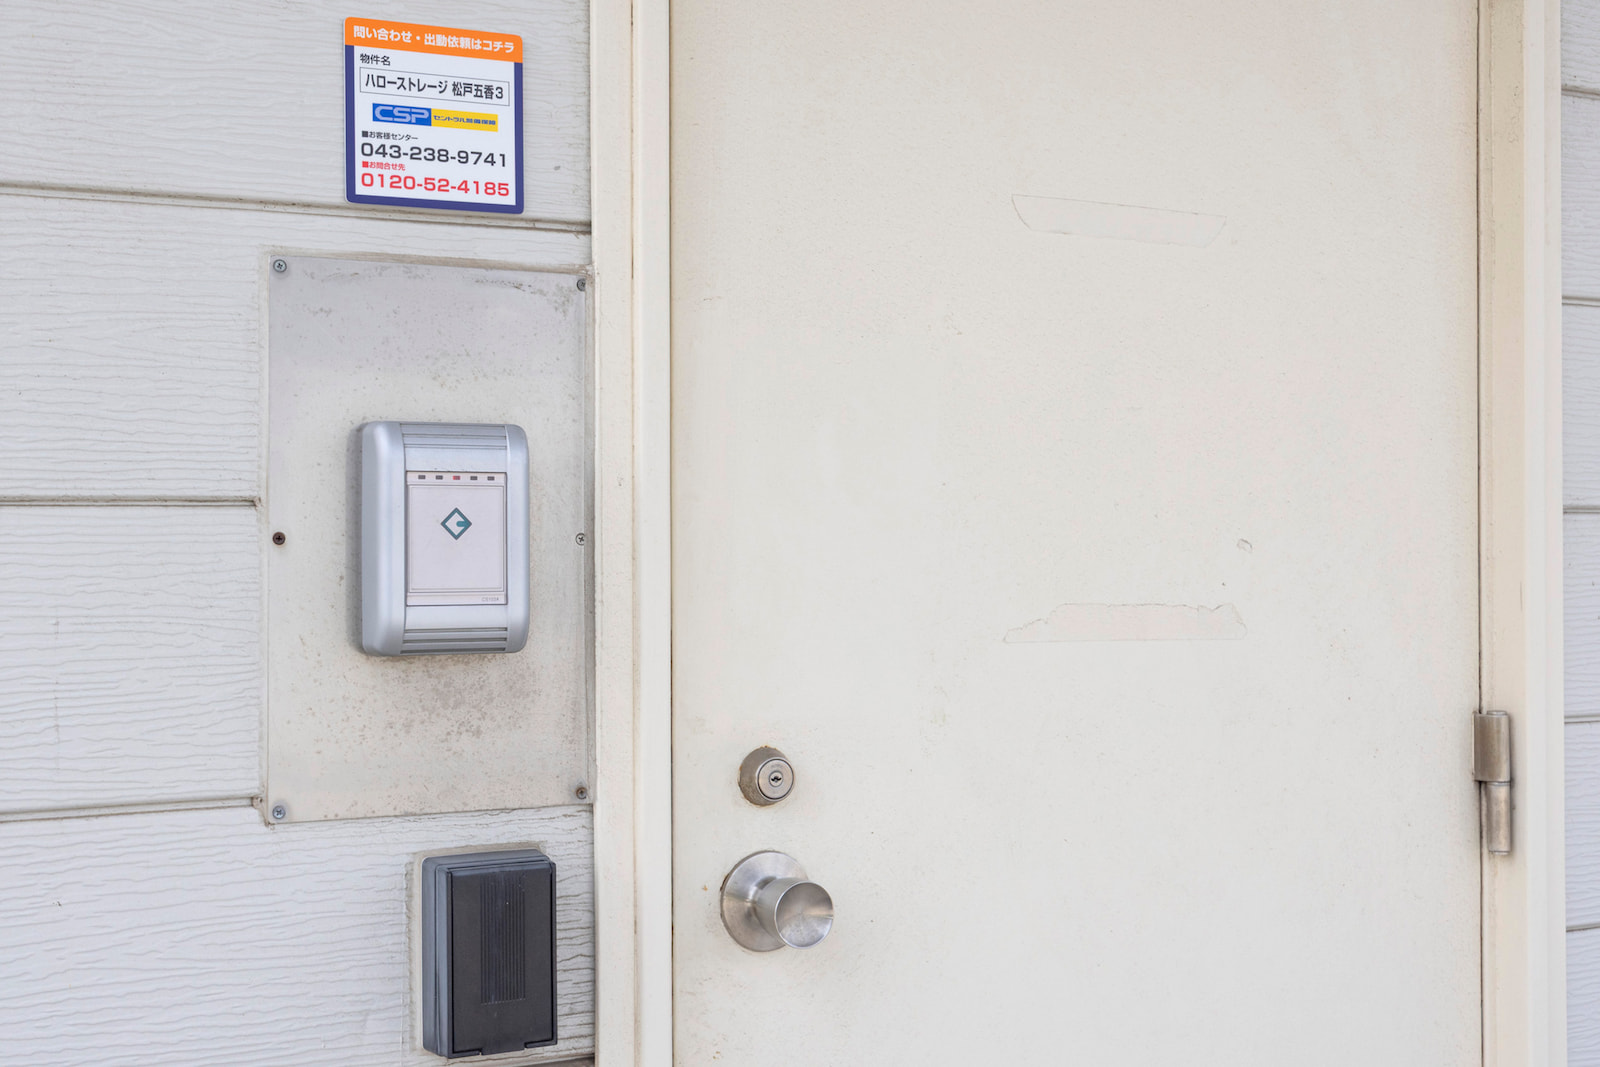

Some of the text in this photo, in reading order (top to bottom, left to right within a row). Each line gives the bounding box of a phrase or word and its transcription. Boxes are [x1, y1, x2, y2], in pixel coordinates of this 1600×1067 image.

[353, 25, 514, 53] 問い合わせ・出動依頼はコチラ
[360, 53, 391, 66] 物件名
[365, 73, 504, 100] ハローストレージ 松戸五香3
[374, 105, 430, 124] CSP
[433, 115, 496, 126] セントラル
[361, 142, 506, 167] 043-238-9741
[361, 173, 510, 197] 0120-52-4185
